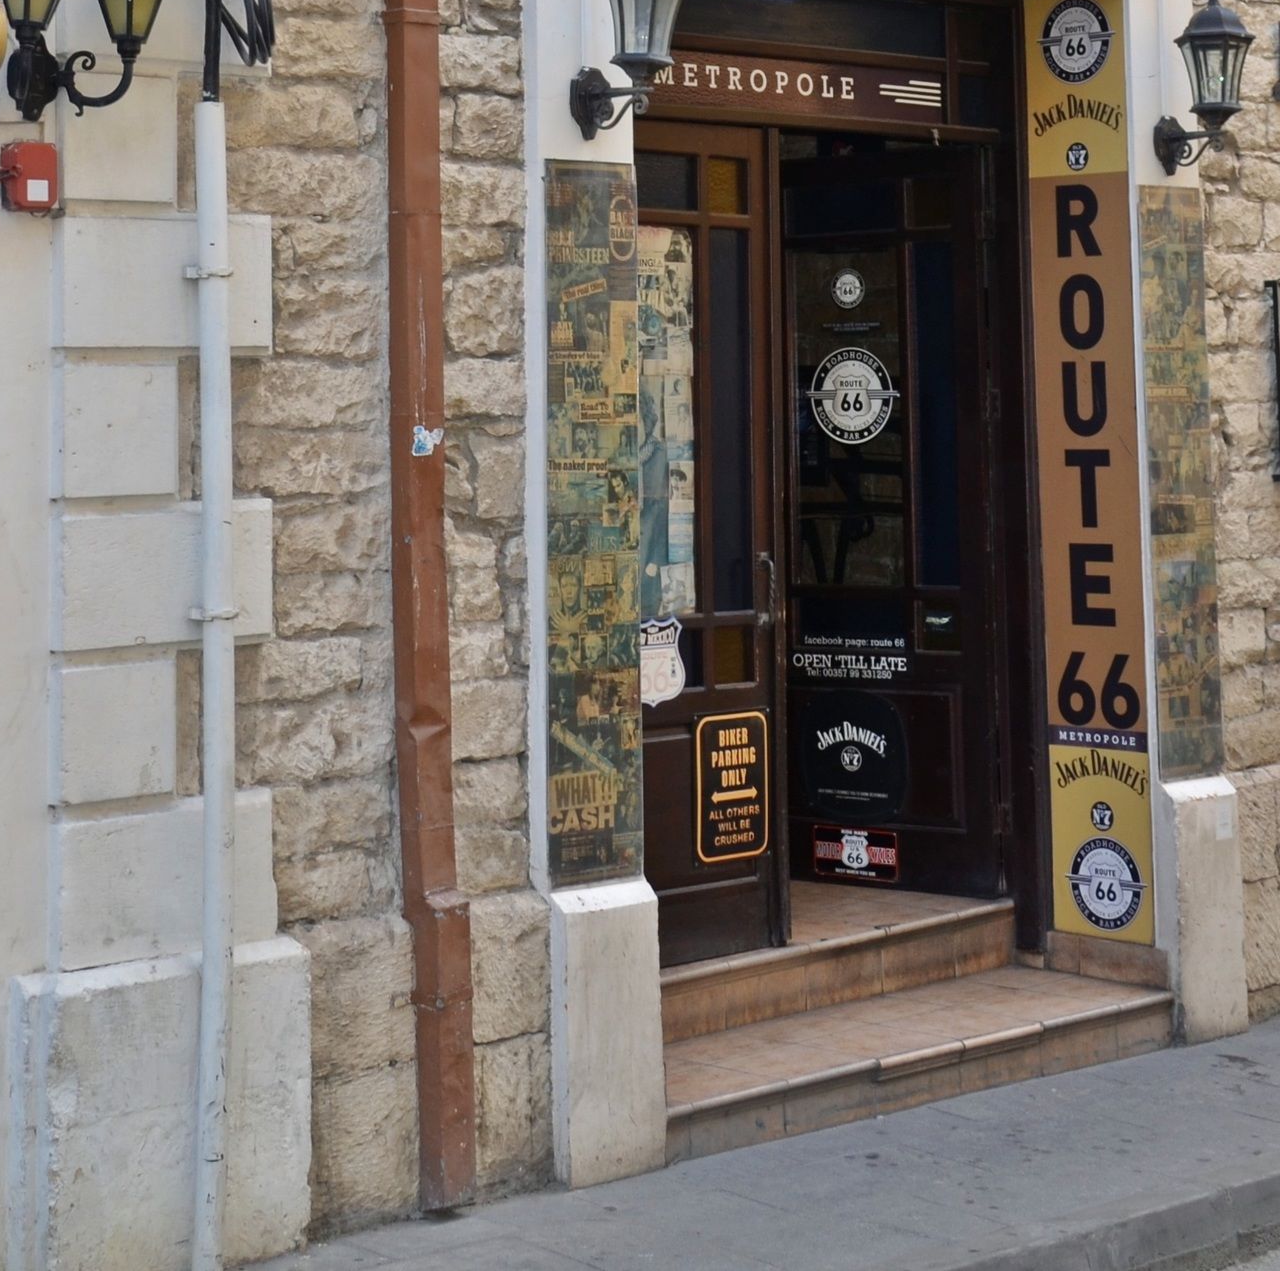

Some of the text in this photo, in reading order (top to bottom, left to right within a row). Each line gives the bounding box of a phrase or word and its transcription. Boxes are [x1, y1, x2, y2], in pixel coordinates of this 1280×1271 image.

[1065, 36, 1087, 57] 66
[653, 62, 855, 100] METROPOLE
[1032, 93, 1123, 137] JACK DANIEL'S
[842, 286, 853, 296] 66
[825, 351, 880, 370] ROADHOUSE
[839, 380, 863, 388] ROUTE
[840, 392, 863, 412] 66
[1055, 183, 1118, 628] ROUTE
[816, 406, 888, 440] ROCK BAR BLUES
[804, 635, 844, 645] facebook
[870, 638, 893, 647] route
[894, 638, 905, 647] 66
[792, 653, 832, 668] OPEN
[870, 656, 907, 672] LATE
[822, 668, 847, 677] 00357
[1057, 650, 1141, 731] 66
[718, 727, 748, 748] BIKER
[816, 721, 887, 754] JACK DANIEL'S
[1058, 730, 1137, 747] METROPOLE
[711, 746, 756, 768] PARKING
[721, 768, 747, 788] ONLY
[1055, 748, 1149, 797] JACK DANIEL'S
[548, 805, 615, 835] CASH
[709, 805, 760, 820] ALL OTHERS
[718, 819, 751, 832] WILL BE
[714, 831, 755, 847] CRUSHED
[847, 852, 864, 865] 66
[1079, 839, 1130, 863] ROADHOUSE
[1094, 867, 1116, 877] ROUTE
[1095, 881, 1117, 902] 66
[1073, 889, 1140, 928] ROCK BAR BLUES
